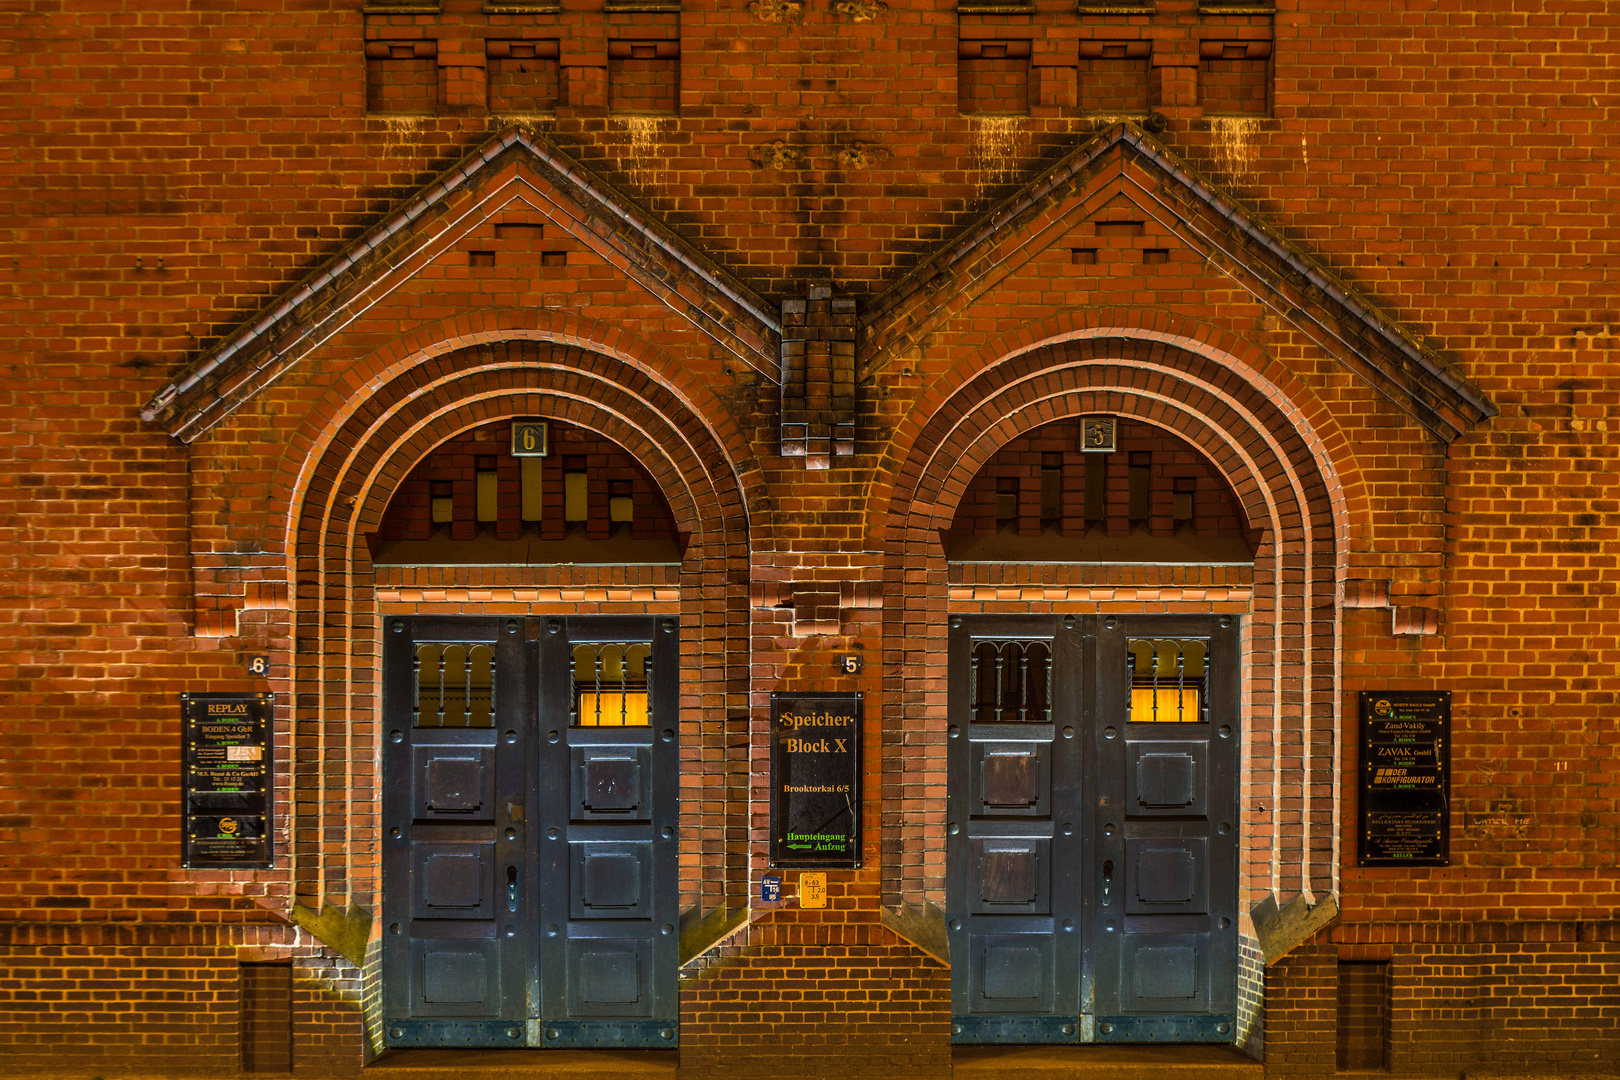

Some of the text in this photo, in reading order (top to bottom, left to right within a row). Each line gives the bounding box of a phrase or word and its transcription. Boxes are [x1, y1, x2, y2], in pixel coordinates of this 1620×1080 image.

[523, 428, 536, 450] 6
[1094, 424, 1104, 445] 5
[253, 657, 265, 673] 6
[845, 656, 857, 673] 5
[207, 704, 248, 713] REPLAY
[783, 711, 851, 731] Speicher
[786, 738, 848, 753] Block X
[1378, 748, 1412, 756] ZAVAK
[783, 784, 850, 793] Brooktorkai 6/5
[786, 832, 846, 842] Haupteingang
[814, 842, 846, 852] Aufzug
